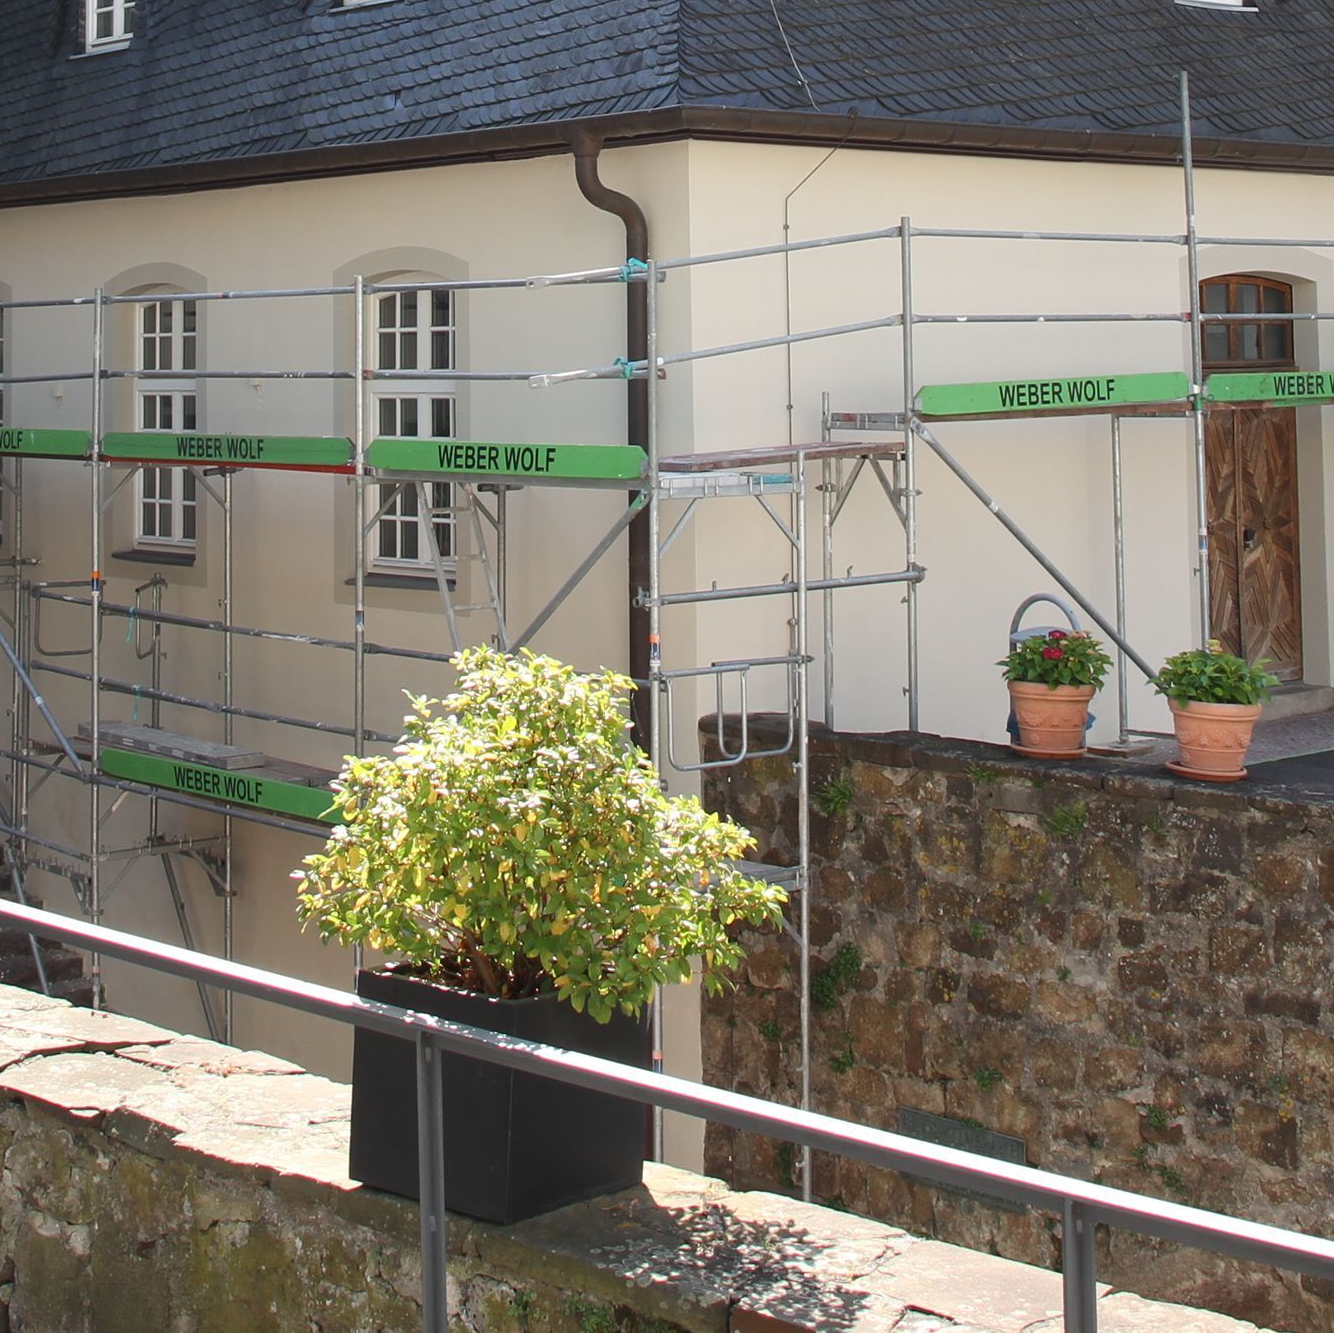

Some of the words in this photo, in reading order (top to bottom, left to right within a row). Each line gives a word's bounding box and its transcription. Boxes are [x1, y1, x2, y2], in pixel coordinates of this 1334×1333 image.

[999, 382, 1063, 407] WEBER
[1067, 379, 1115, 403] WOLF
[1273, 375, 1325, 396] WEBER
[176, 437, 222, 458] WEBER
[226, 438, 264, 459] WOLF
[438, 445, 500, 470] WEBER
[504, 446, 556, 472] WOLF
[173, 765, 221, 795] WEBER
[224, 776, 263, 803] WOLF
